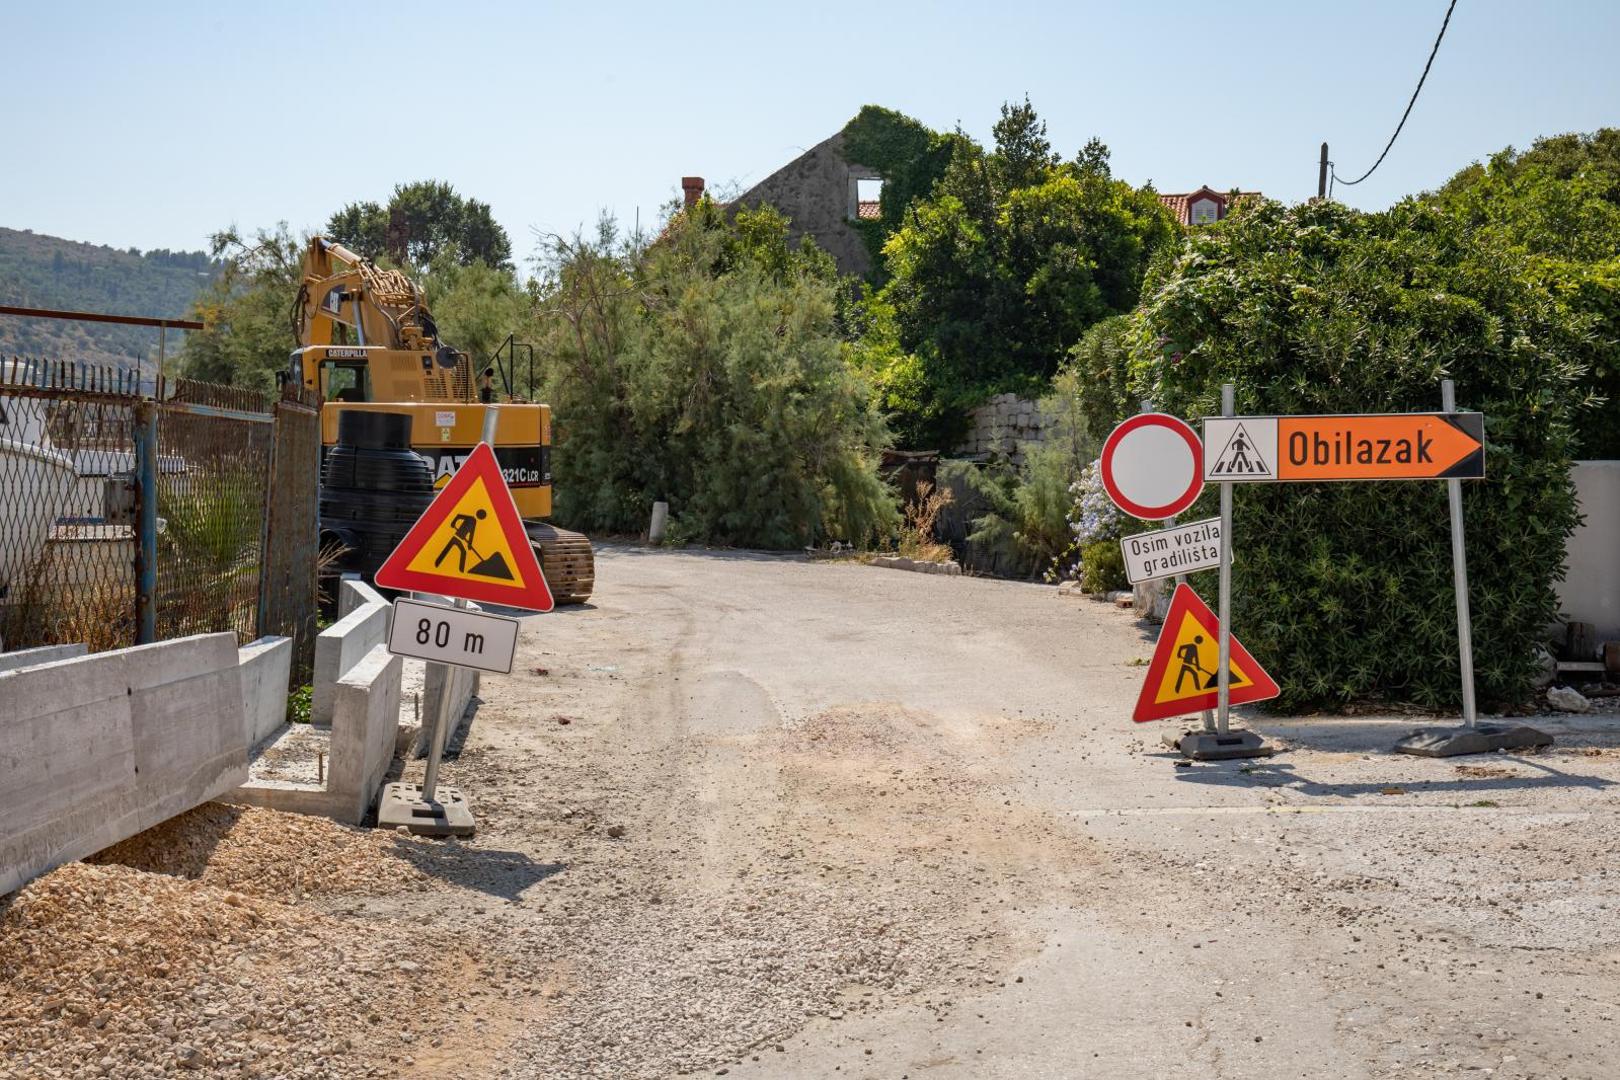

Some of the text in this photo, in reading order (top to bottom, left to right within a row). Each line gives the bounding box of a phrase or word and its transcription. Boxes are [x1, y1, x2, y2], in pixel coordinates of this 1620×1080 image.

[328, 349, 367, 358] CATERPILLA
[1289, 430, 1433, 466] Obilazak
[503, 468, 526, 482] 321C
[527, 471, 539, 482] LCR
[1131, 525, 1220, 556] Osim vozila
[1144, 546, 1218, 576] gradilišta
[416, 618, 484, 654] 80 m
